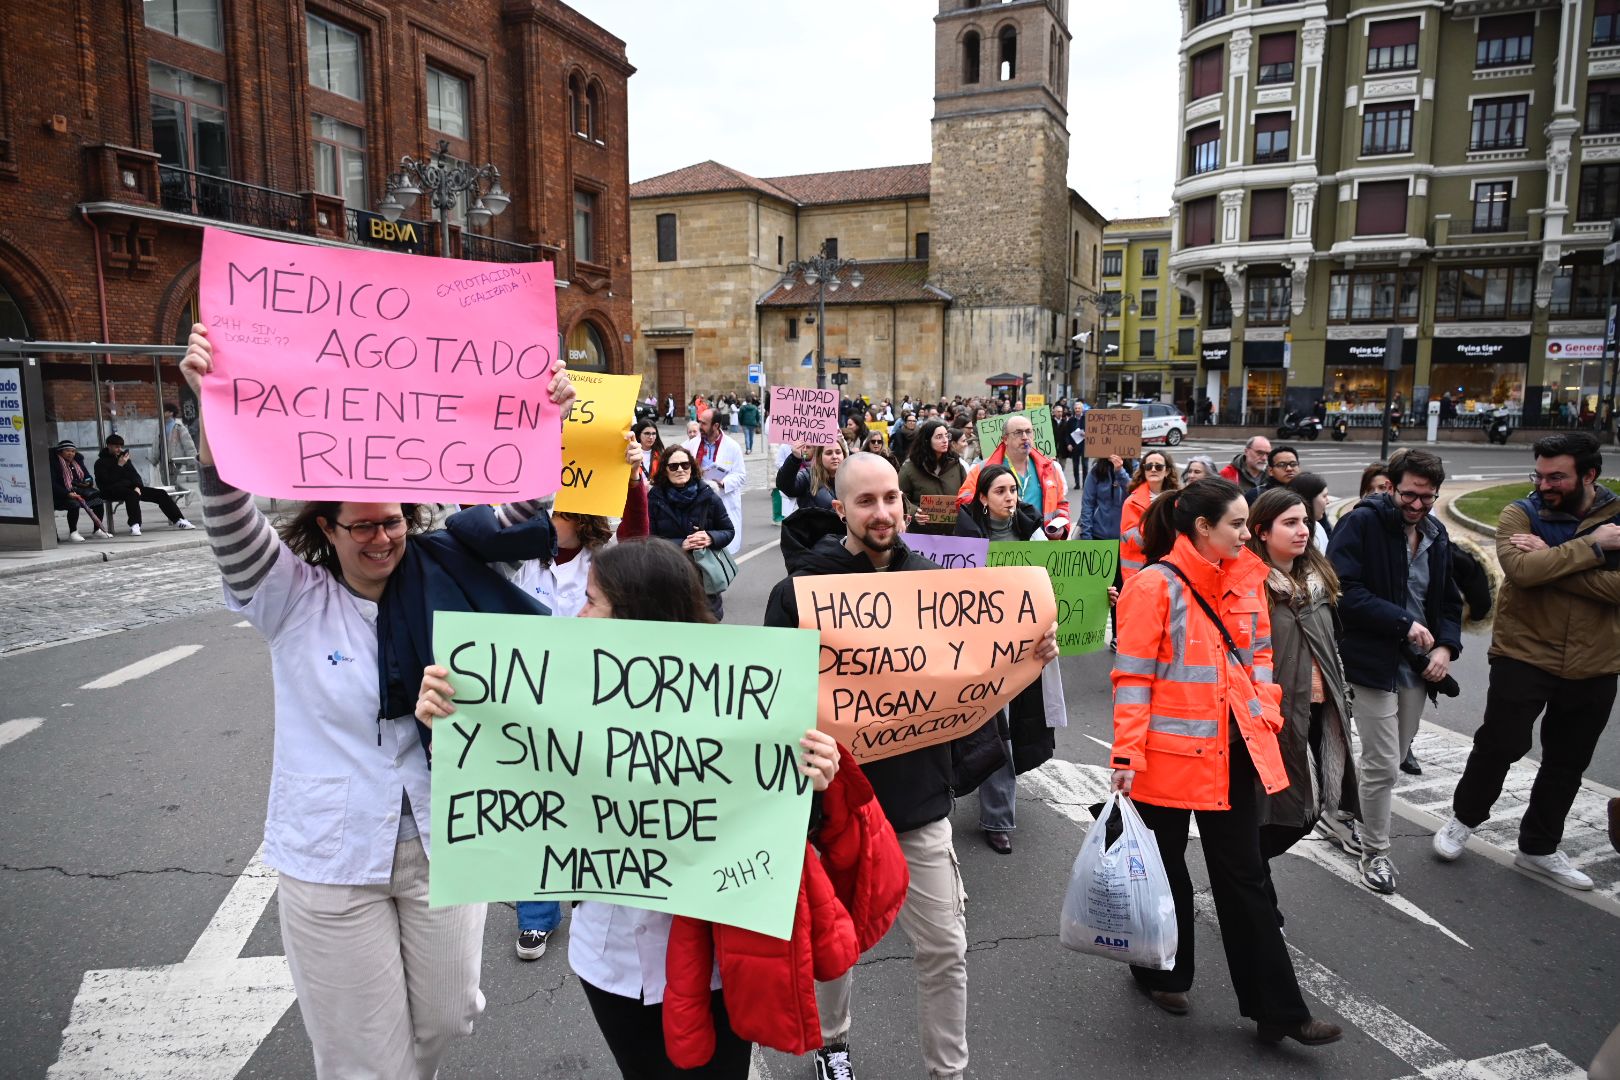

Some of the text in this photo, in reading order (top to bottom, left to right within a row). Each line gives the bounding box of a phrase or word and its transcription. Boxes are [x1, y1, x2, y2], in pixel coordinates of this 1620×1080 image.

[370, 218, 418, 244] BBVA
[228, 262, 411, 320] MÉDICO
[315, 328, 551, 380] AGOTADO
[569, 349, 588, 360] BBVA
[1457, 344, 1503, 353] flying tiger
[233, 377, 541, 431] PACIENTE EN
[566, 399, 595, 424] ES
[776, 387, 835, 404] SANIDAD
[793, 402, 837, 419] HUMANA
[771, 414, 826, 430] HORARIOS
[782, 428, 834, 444] HUMANOS
[297, 430, 523, 487] RIESGO
[1046, 549, 1113, 579] QUITANDO
[811, 589, 1038, 631] HAGO HORAS A
[449, 640, 551, 706] SIN
[818, 638, 1034, 676] DESTAJO Y ME
[832, 677, 1005, 723] PAGAN CON
[861, 710, 978, 750] VOCACION
[452, 721, 814, 796] Y SIN PARAR UN
[447, 788, 718, 845] ERROR PUEDE
[540, 845, 674, 892] MATAR
[1094, 935, 1130, 949] ALDI
